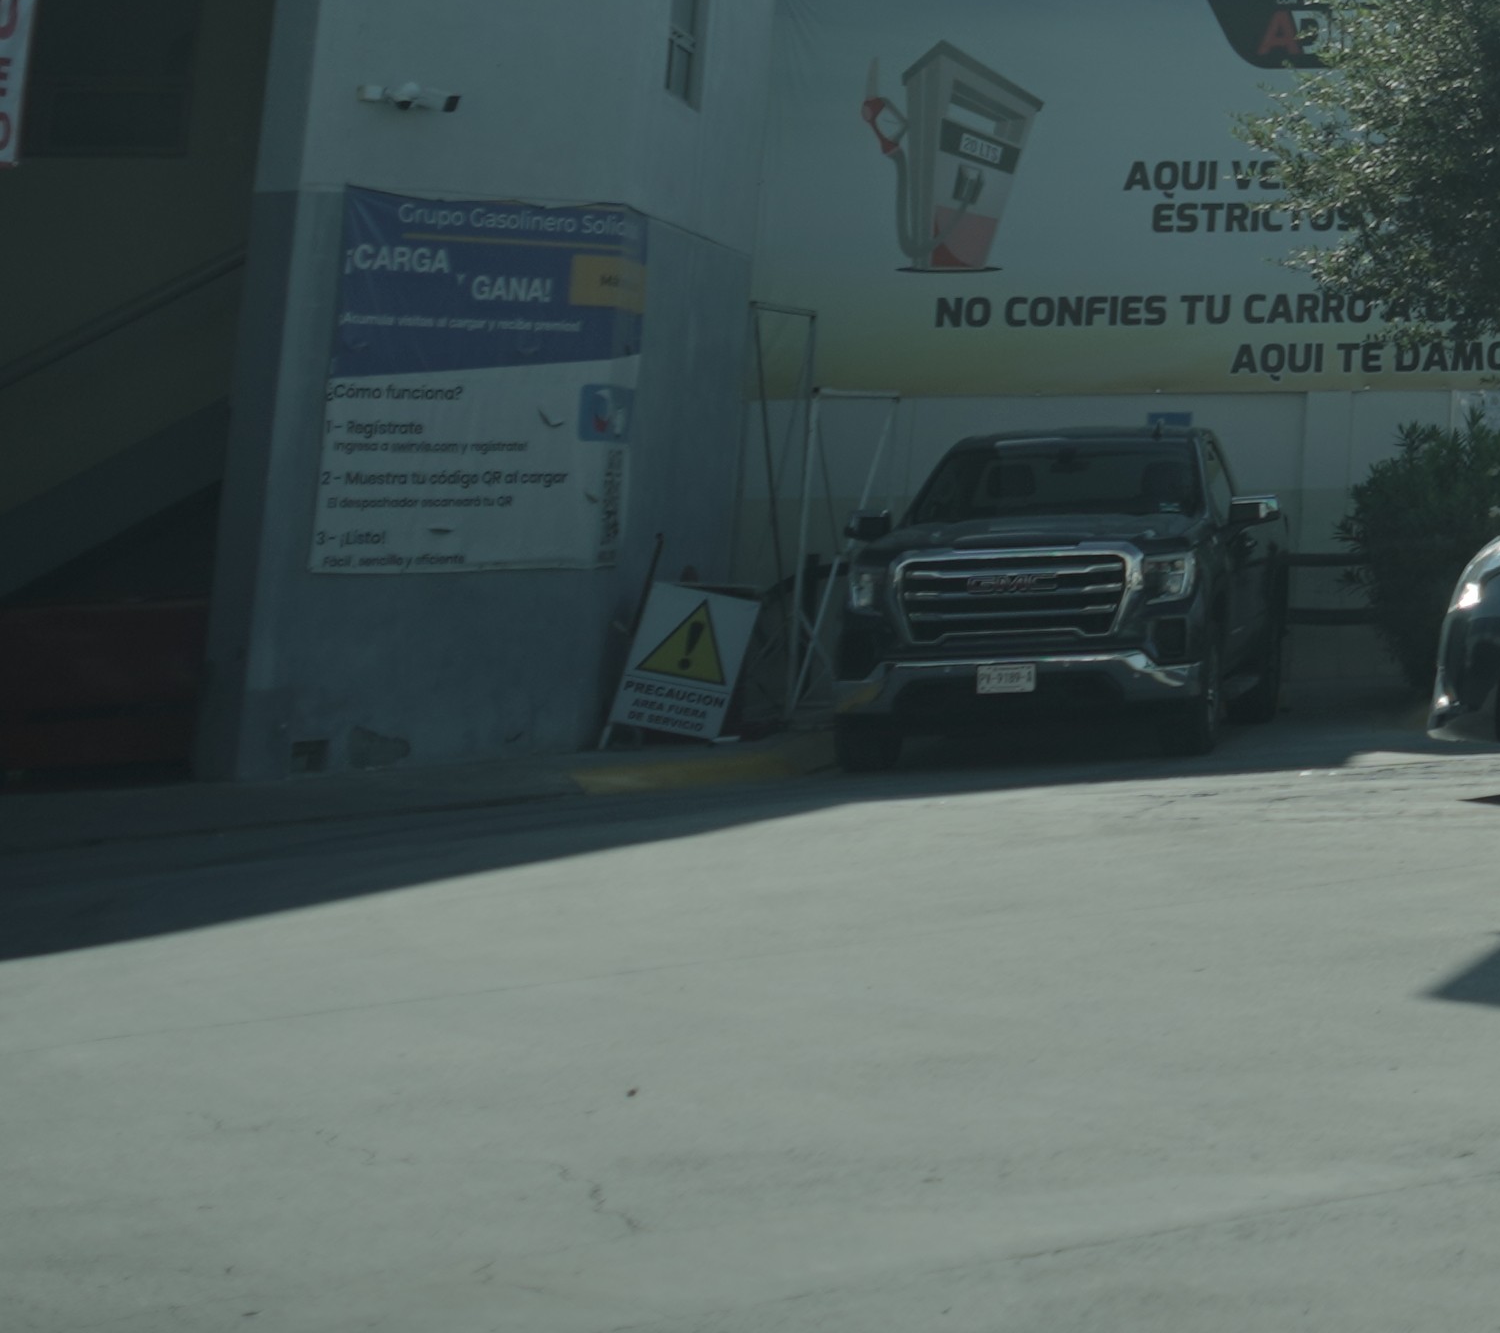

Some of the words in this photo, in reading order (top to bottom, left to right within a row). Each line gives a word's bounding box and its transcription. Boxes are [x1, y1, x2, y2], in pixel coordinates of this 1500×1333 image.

[1122, 160, 1217, 197] AQUI
[399, 203, 464, 229] Grupo
[469, 207, 576, 233] Gasolinero
[344, 243, 450, 275] ¡CARGA
[471, 275, 553, 303] GANA!
[934, 295, 992, 328] NO
[1003, 294, 1167, 327] CONFIES
[1180, 293, 1233, 325] TU
[1243, 293, 1373, 324] CARRO
[1229, 342, 1324, 382] AQUI
[1336, 342, 1384, 373] TE
[326, 382, 382, 401] ¿Cómo
[385, 384, 464, 401] funciona?
[345, 470, 408, 484] Muestra
[411, 471, 426, 484] tu
[429, 469, 479, 489] código
[482, 471, 503, 486] QR
[504, 470, 520, 484] al
[966, 572, 1060, 595] GMC
[623, 679, 727, 709] PRECAUCION
[627, 710, 644, 722] DE
[646, 714, 705, 732] SERVICIO
[631, 698, 665, 712] AREA
[667, 704, 708, 720] FUERA
